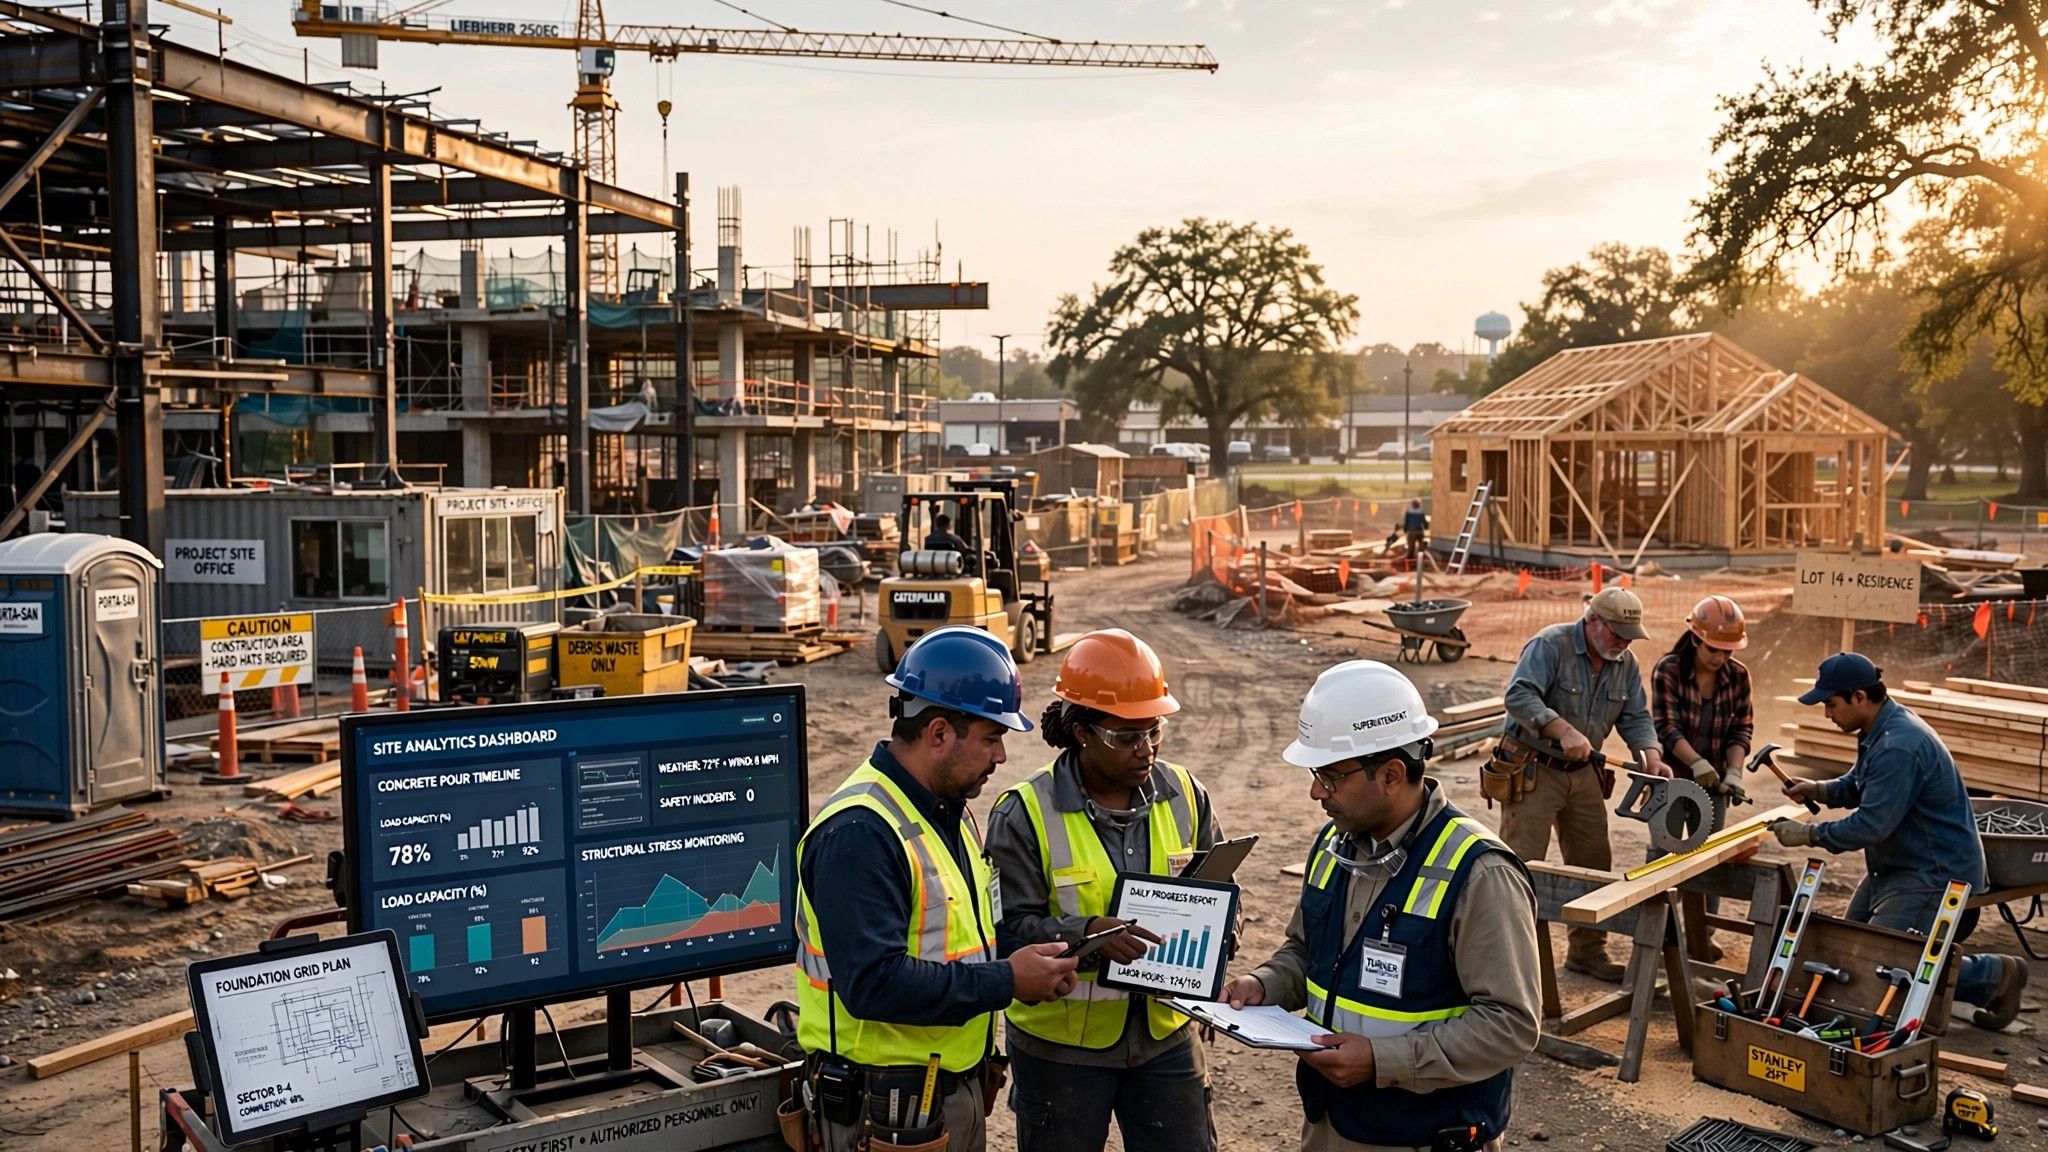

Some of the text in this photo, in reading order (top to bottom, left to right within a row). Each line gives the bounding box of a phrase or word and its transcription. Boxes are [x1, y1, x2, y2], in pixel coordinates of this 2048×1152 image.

[451, 19, 516, 34] LIEBHERR
[519, 23, 559, 38] 250EC
[175, 547, 256, 560] PROJECT SITE
[194, 562, 236, 575] OFFICE
[1801, 569, 1914, 590] LOT 14 RESIDENCE
[227, 618, 291, 636] CAUTION
[211, 635, 304, 653] CONSTRUCTION AREA
[568, 640, 639, 655] DEBRIS WASTE
[212, 649, 308, 669] HARD HATS REQUIRED
[591, 657, 616, 672] ONLY
[373, 729, 557, 755] SITE ANALYTICS DASHBOARD
[658, 759, 701, 773] WEATHER:
[728, 756, 754, 768] WIND:
[761, 753, 779, 765] MPH
[378, 768, 521, 792] CONCRETE POUR TIMELINE
[659, 794, 691, 808] SAFETY
[693, 790, 736, 805] INCIDENTS:
[746, 788, 755, 801] 0
[380, 817, 402, 828] LOAD
[402, 813, 439, 826] CAPACITY
[389, 843, 431, 866] 78%
[581, 831, 745, 861] STRUCTURAL STRESS MONITORING
[381, 884, 487, 909] LOAD CAPACITY (%)
[1130, 887, 1218, 907] DAILY PROGRESS REPORT
[215, 957, 351, 994] FOUNDATION GRID PLAN
[1117, 967, 1140, 978] LABOR
[1752, 1049, 1802, 1073] STANLEY
[237, 1082, 292, 1105] SECTOR B-4
[541, 1136, 575, 1152] FIRST
[589, 1116, 661, 1146] AUTHORIZED
[664, 1104, 728, 1129] PERSONNEL
[730, 1095, 758, 1114] ONLY
